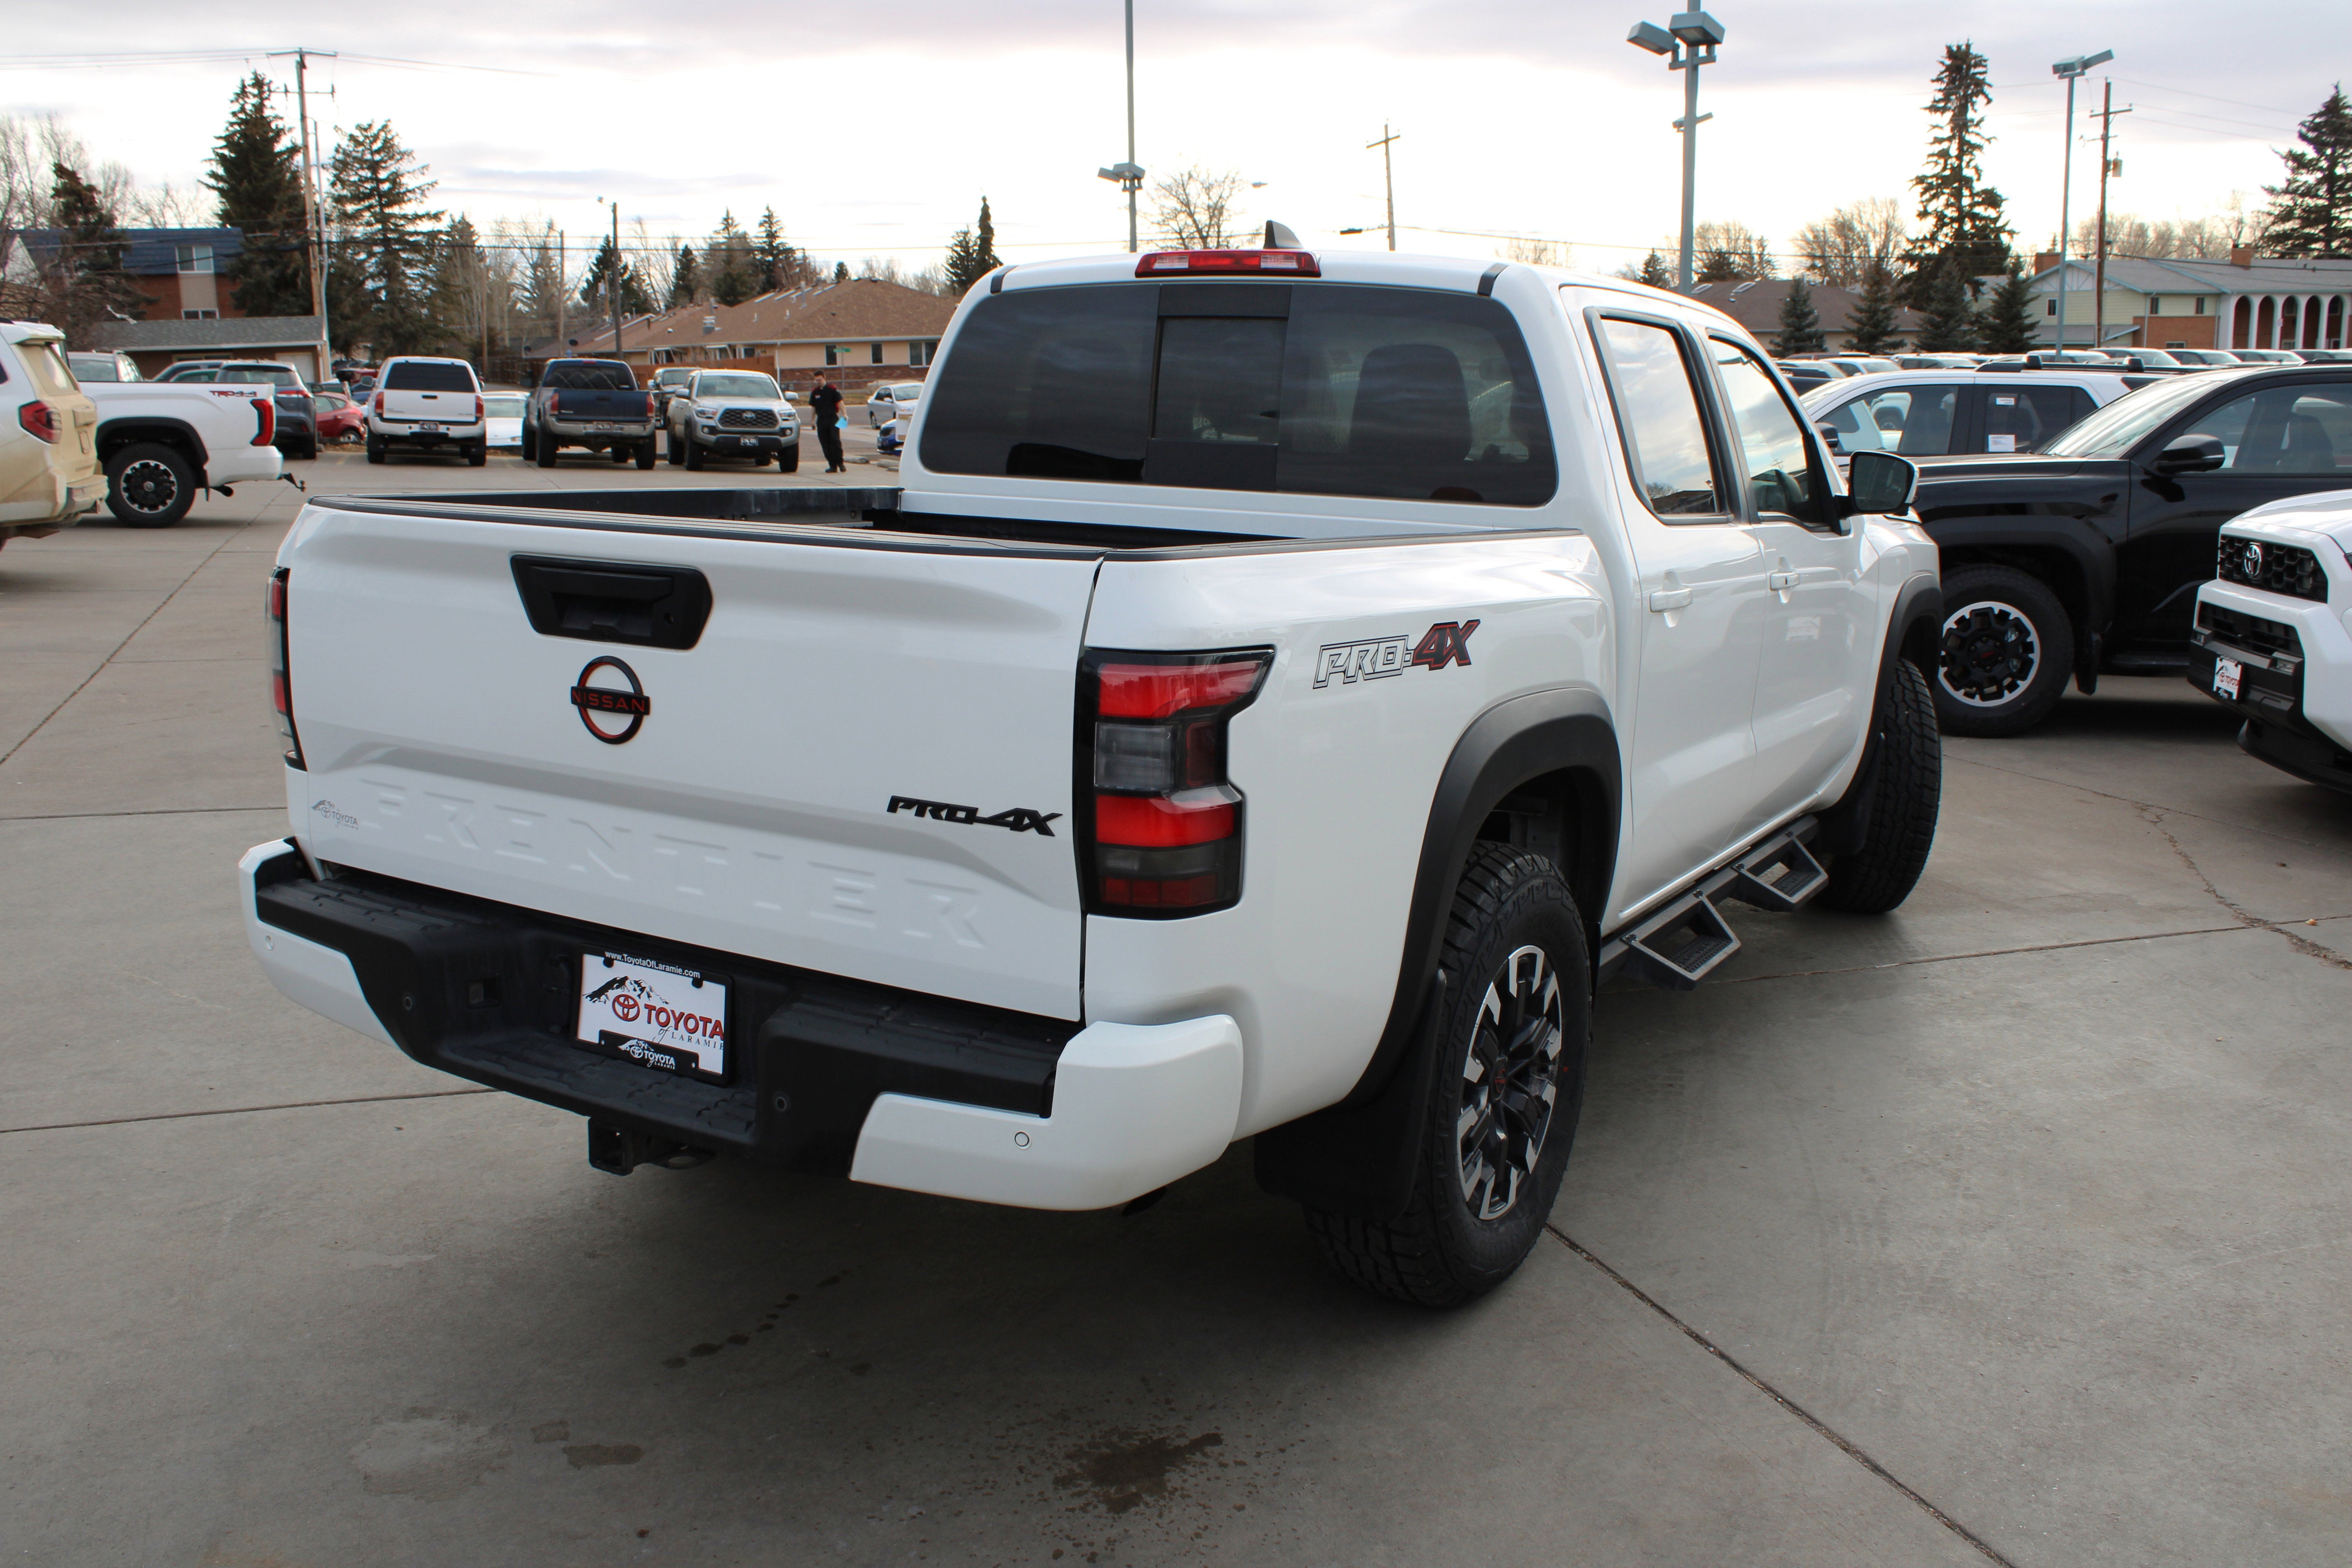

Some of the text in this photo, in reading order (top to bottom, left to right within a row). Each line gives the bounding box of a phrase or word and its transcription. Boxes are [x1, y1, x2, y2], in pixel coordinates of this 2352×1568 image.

[1312, 619, 1481, 689] PRO-4X
[572, 689, 646, 712] NISSAN
[332, 811, 358, 826] TOYOTA
[886, 795, 1064, 837] PRO-4X
[359, 779, 987, 949] FRONTIER
[605, 950, 701, 979] www.ToyotaOfLaramie.com
[644, 1003, 724, 1040] TOYOTA
[653, 1026, 724, 1051] of LARAMIE
[644, 1050, 676, 1066] TOYOTA
[654, 1061, 676, 1070] LARAMIE
